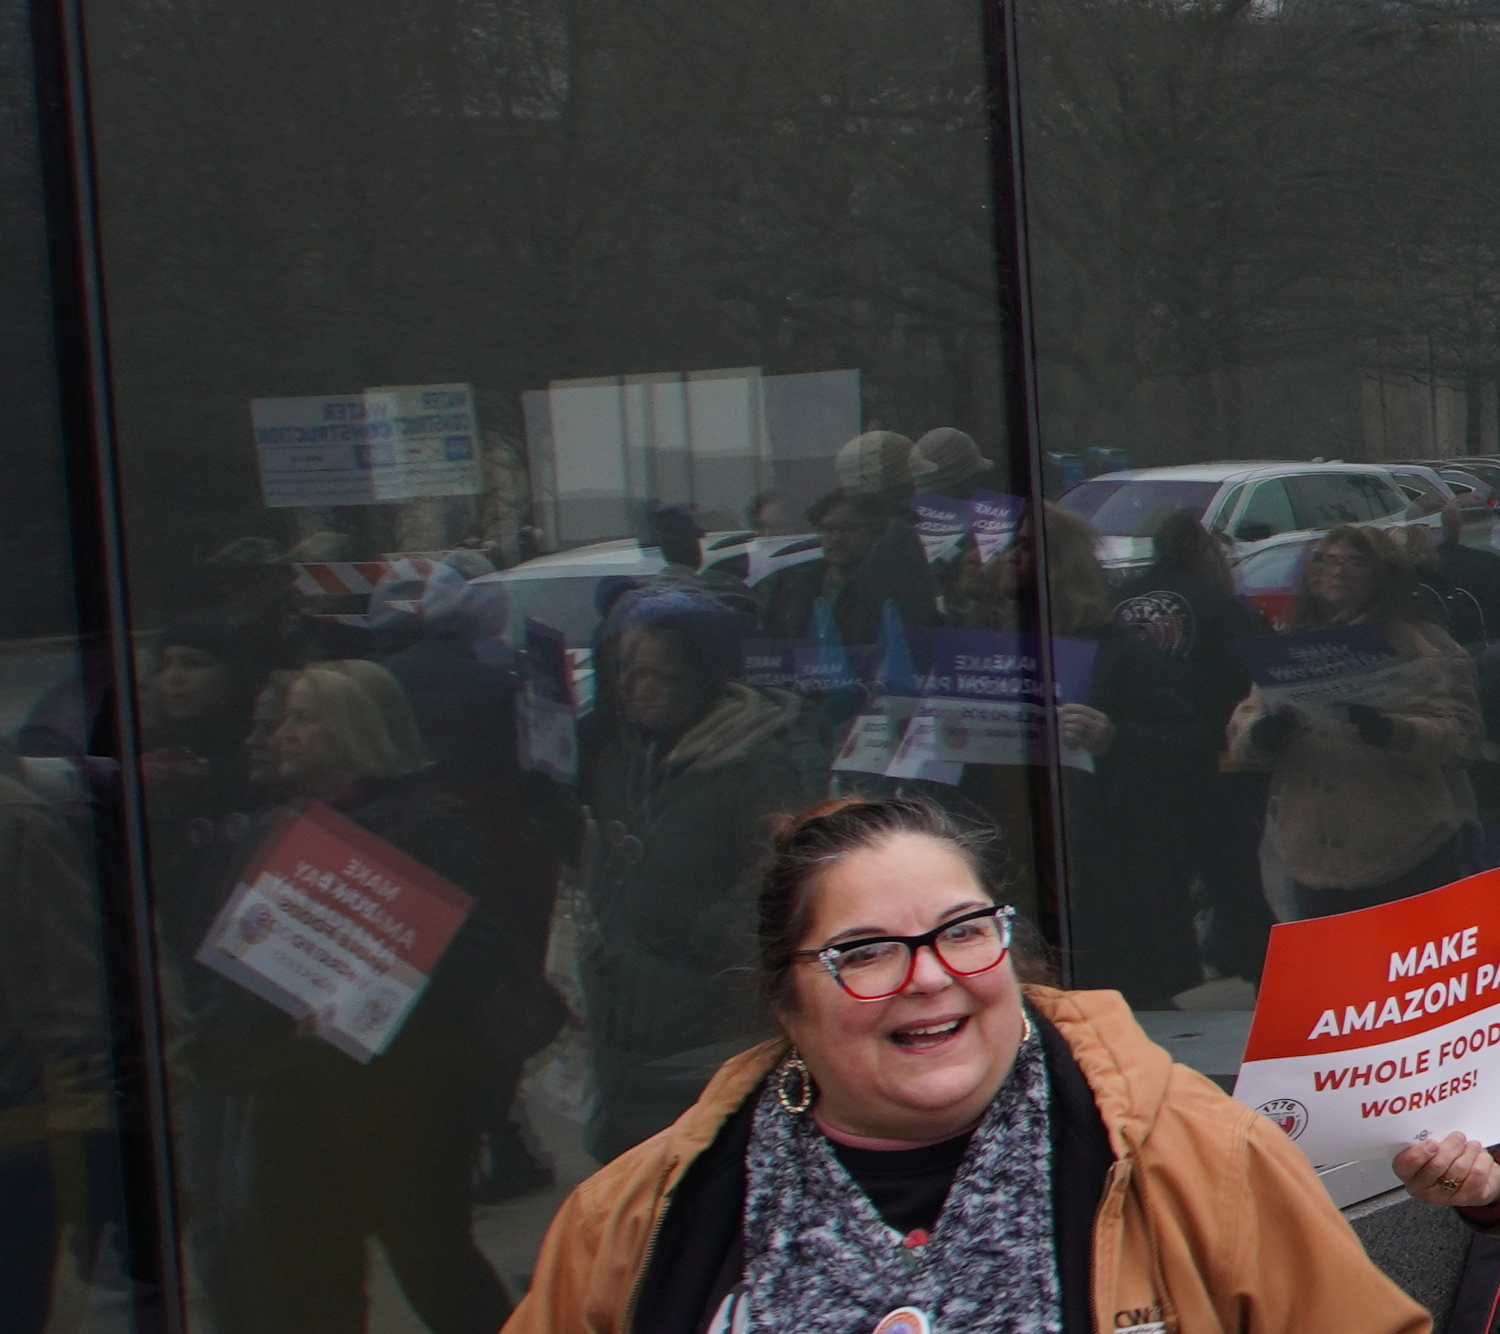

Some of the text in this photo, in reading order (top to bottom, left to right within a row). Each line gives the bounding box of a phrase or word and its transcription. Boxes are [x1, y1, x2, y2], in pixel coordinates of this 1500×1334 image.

[1387, 925, 1479, 982] MAKE
[1306, 972, 1468, 1040] AMAZON
[1313, 1049, 1431, 1092] WHOLE
[1360, 1069, 1479, 1119] WORKERS!
[1263, 1099, 1296, 1112] 1776
